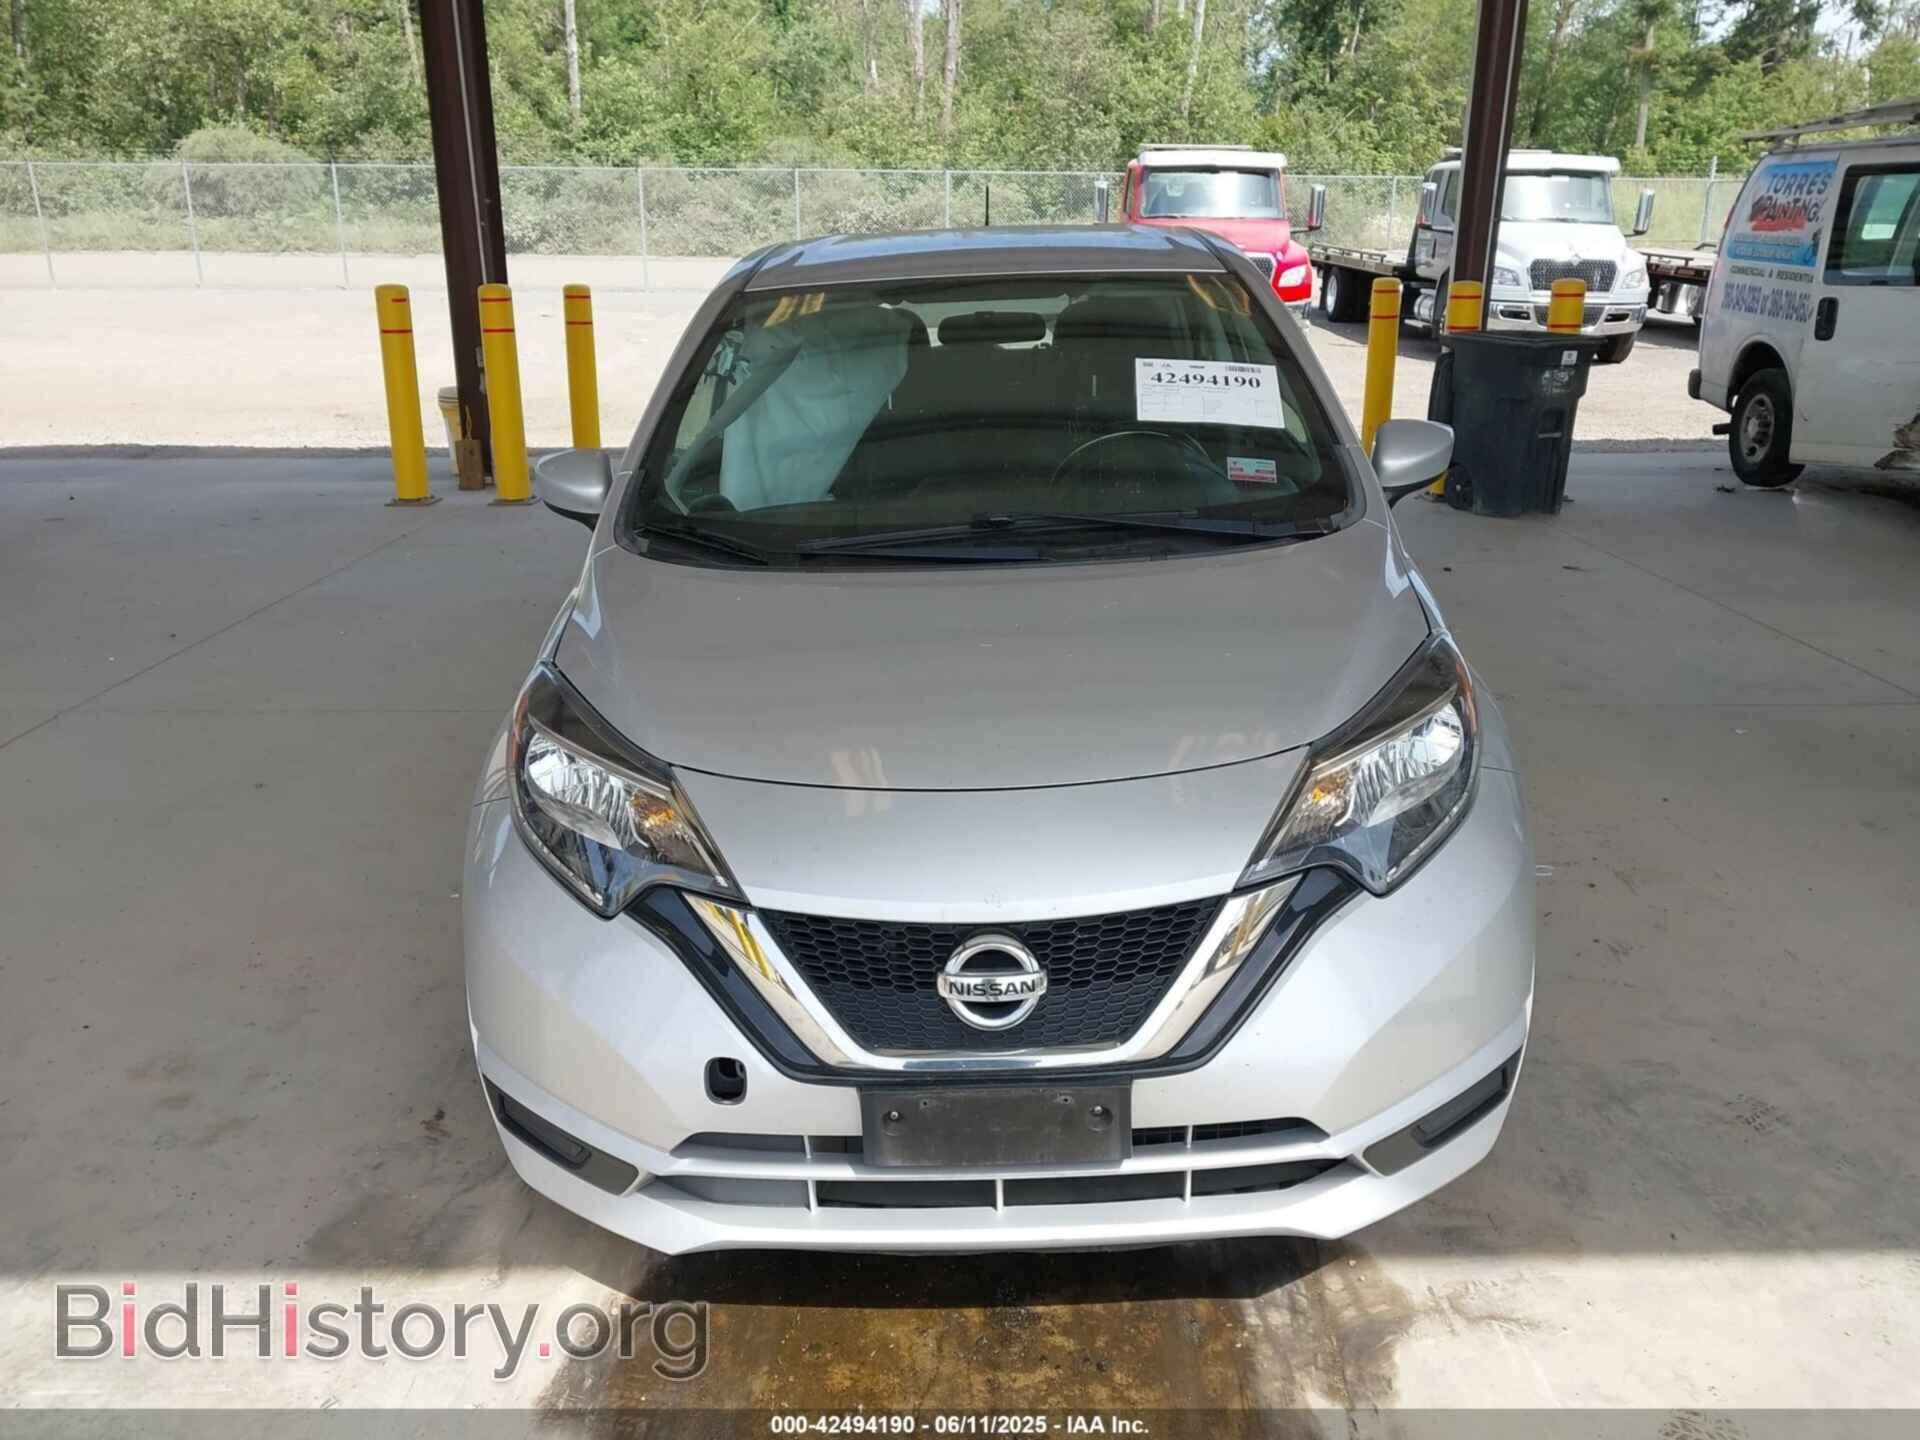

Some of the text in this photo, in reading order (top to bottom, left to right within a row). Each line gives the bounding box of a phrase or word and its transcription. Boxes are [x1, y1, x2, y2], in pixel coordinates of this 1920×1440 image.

[1767, 172, 1830, 195] TORRES
[1151, 371, 1261, 388] 42494190
[949, 980, 1036, 996] NISSAN
